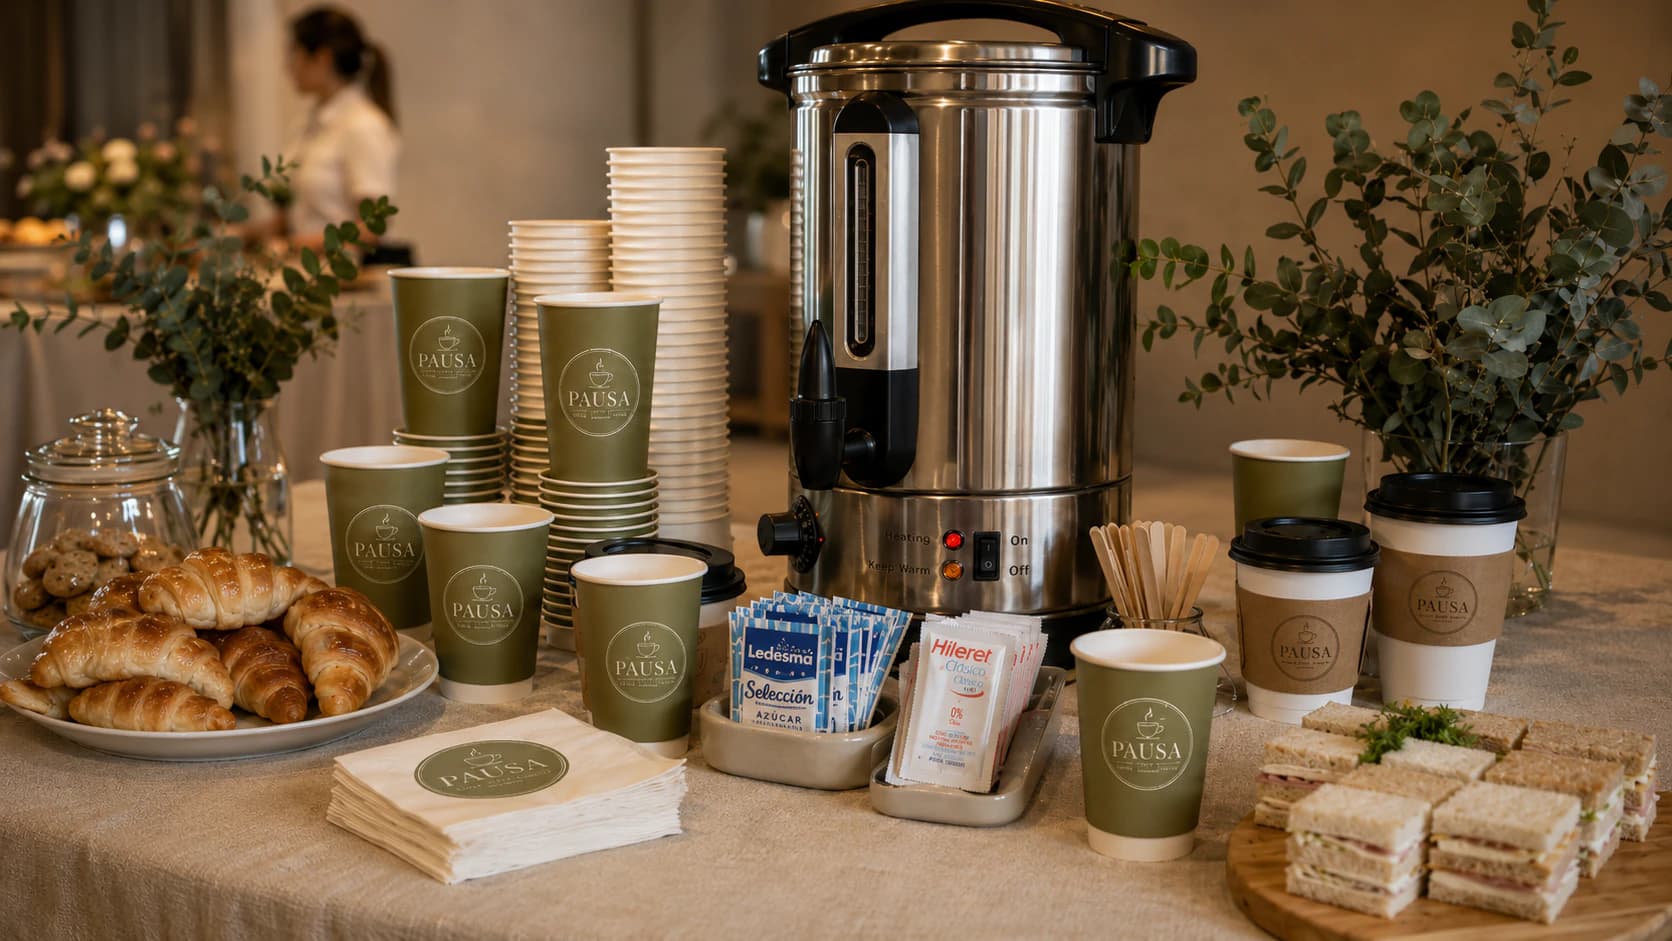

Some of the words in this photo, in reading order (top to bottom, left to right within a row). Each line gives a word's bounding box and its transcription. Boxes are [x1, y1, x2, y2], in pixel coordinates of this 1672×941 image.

[418, 353, 477, 369] PAUSA
[568, 390, 631, 408] PAUSA
[885, 531, 931, 545] Heating
[1010, 536, 1029, 546] On
[355, 542, 416, 558] PAUSA
[868, 559, 895, 574] Keep
[899, 564, 931, 576] Warm
[1009, 565, 1030, 577] Off
[453, 602, 515, 619] PAUSA
[1417, 598, 1469, 614] PAUSA
[748, 643, 814, 666] Ledesma
[931, 638, 993, 664] Hileret
[1280, 644, 1332, 660] PAUSA
[616, 659, 678, 677] PAUSA
[744, 679, 815, 706] Selección
[756, 710, 803, 725] AZÚCAR
[950, 706, 964, 720] 0%
[1112, 740, 1182, 761] PAUSA
[440, 758, 549, 788] PAUSA
